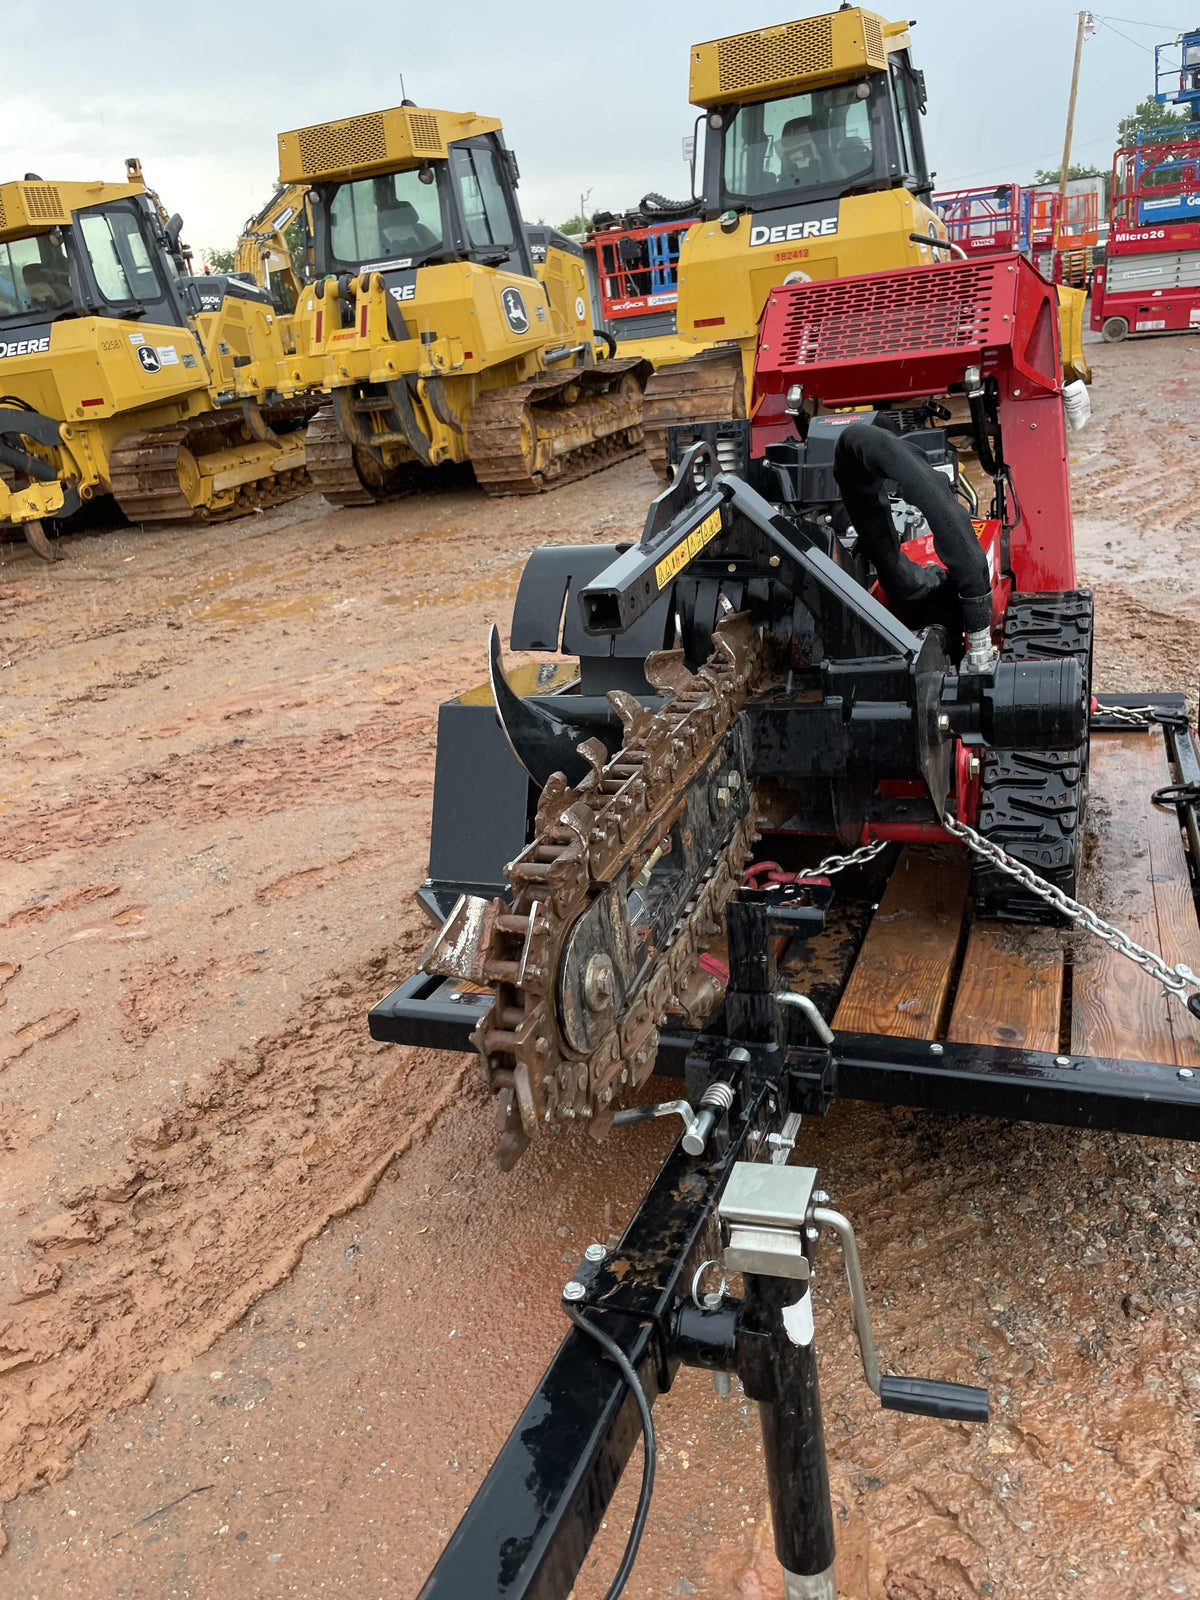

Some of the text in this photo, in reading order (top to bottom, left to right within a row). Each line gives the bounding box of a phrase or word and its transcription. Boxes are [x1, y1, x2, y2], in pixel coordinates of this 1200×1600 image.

[750, 217, 838, 246] DEERE
[1115, 230, 1165, 242] Micro26
[776, 249, 809, 261] 182412
